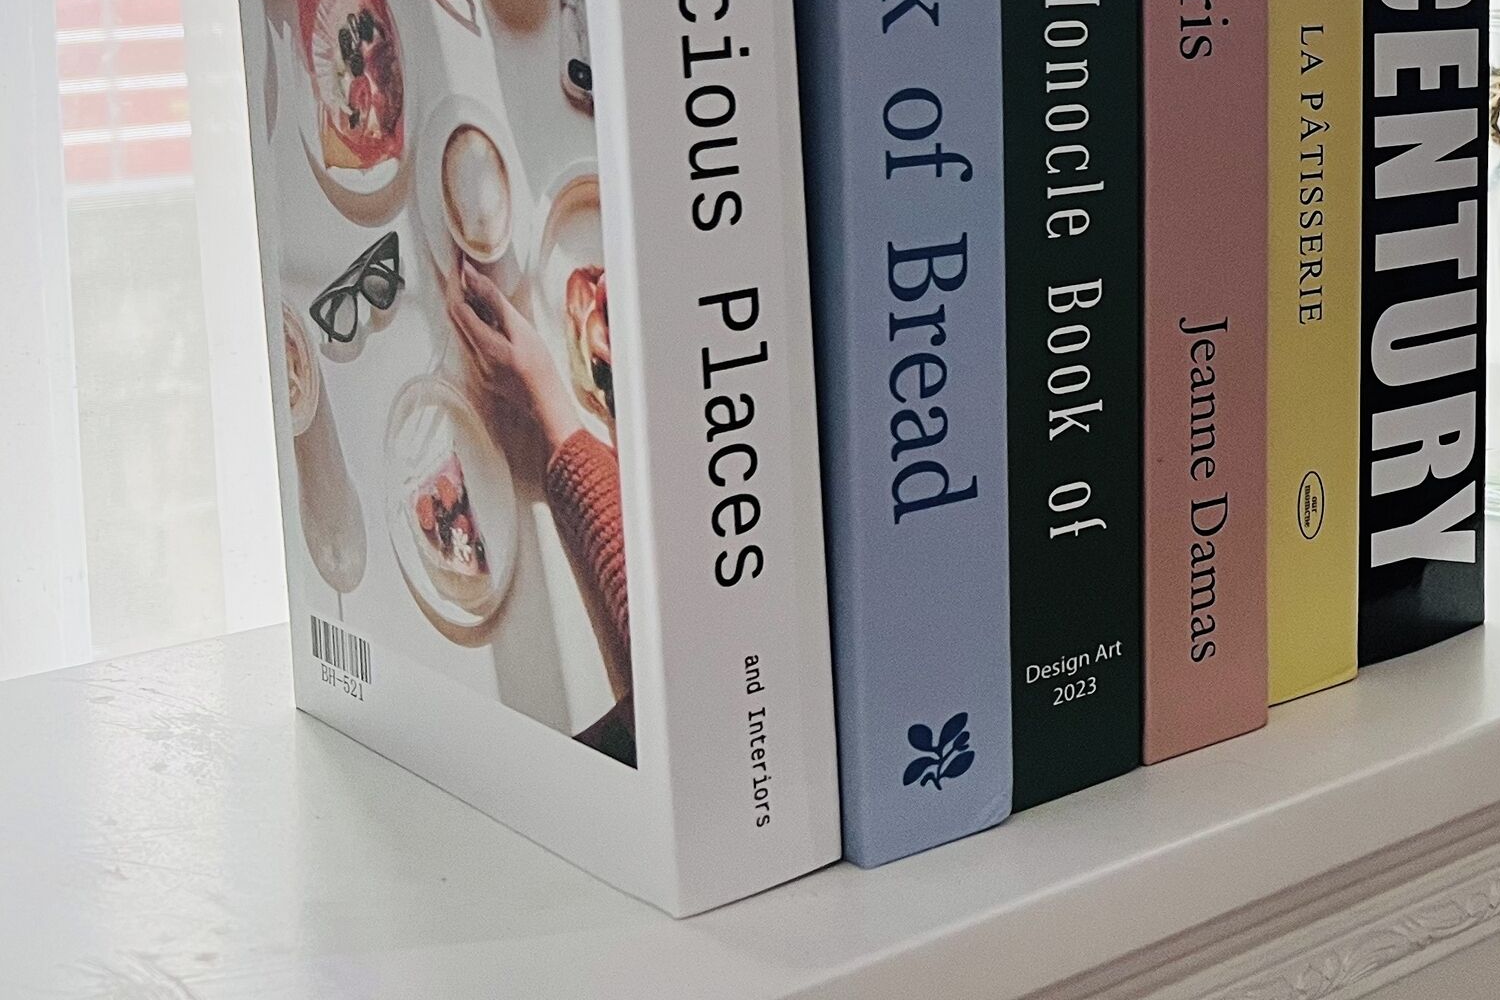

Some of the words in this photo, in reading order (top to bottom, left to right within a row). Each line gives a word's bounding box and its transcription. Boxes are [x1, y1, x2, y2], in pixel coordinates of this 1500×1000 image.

[1300, 24, 1325, 76] LA
[882, 87, 974, 184] of
[1300, 90, 1330, 326] PÂTISSERIE
[886, 232, 979, 525] Bread
[1046, 278, 1103, 442] Book
[1179, 315, 1228, 482] Jeanne
[697, 287, 770, 590] Places
[1047, 480, 1108, 539] of
[1189, 492, 1229, 664] Damas
[321, 663, 364, 701] BH-521
[744, 654, 766, 695] and
[1026, 653, 1090, 684] Design
[1095, 640, 1123, 662] Art
[1052, 676, 1097, 706] 2023
[748, 706, 772, 828] Interiors
